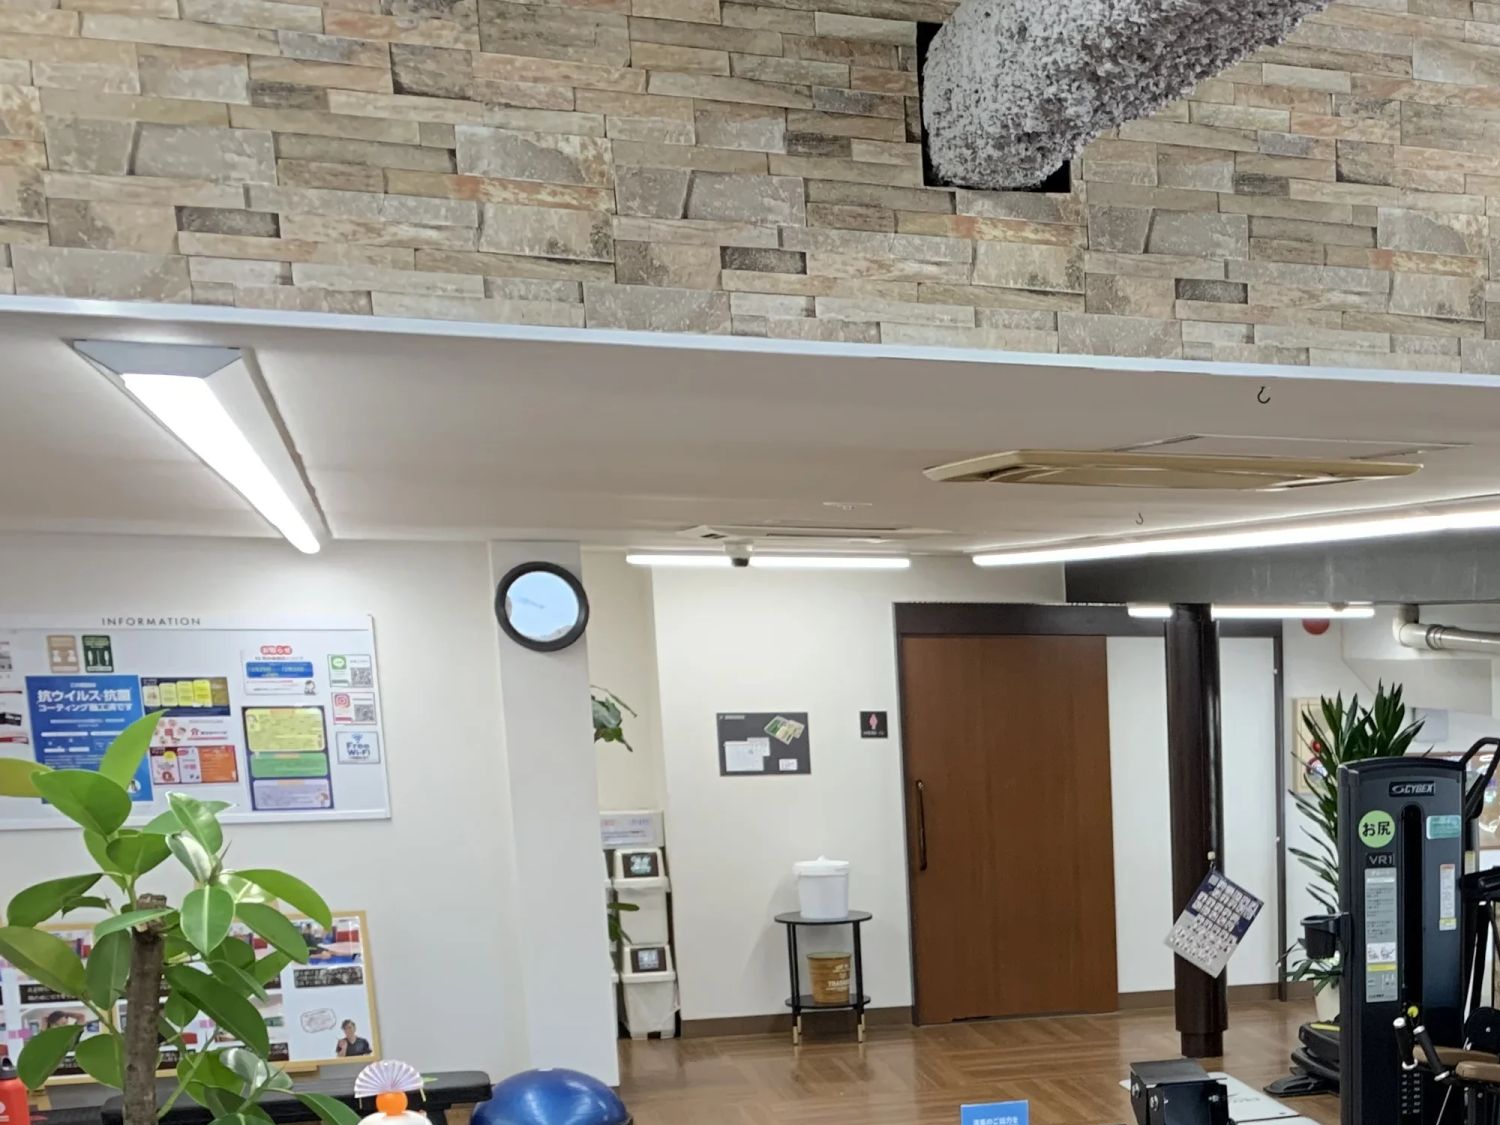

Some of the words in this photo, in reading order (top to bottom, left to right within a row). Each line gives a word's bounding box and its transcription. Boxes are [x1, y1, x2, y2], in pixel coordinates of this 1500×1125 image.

[101, 617, 201, 626] INFORMATION
[346, 742, 370, 750] Free
[347, 749, 371, 757] Wi-Fi
[1404, 783, 1434, 794] CYBEX
[1362, 821, 1391, 837] お尻
[1368, 855, 1393, 865] VR1
